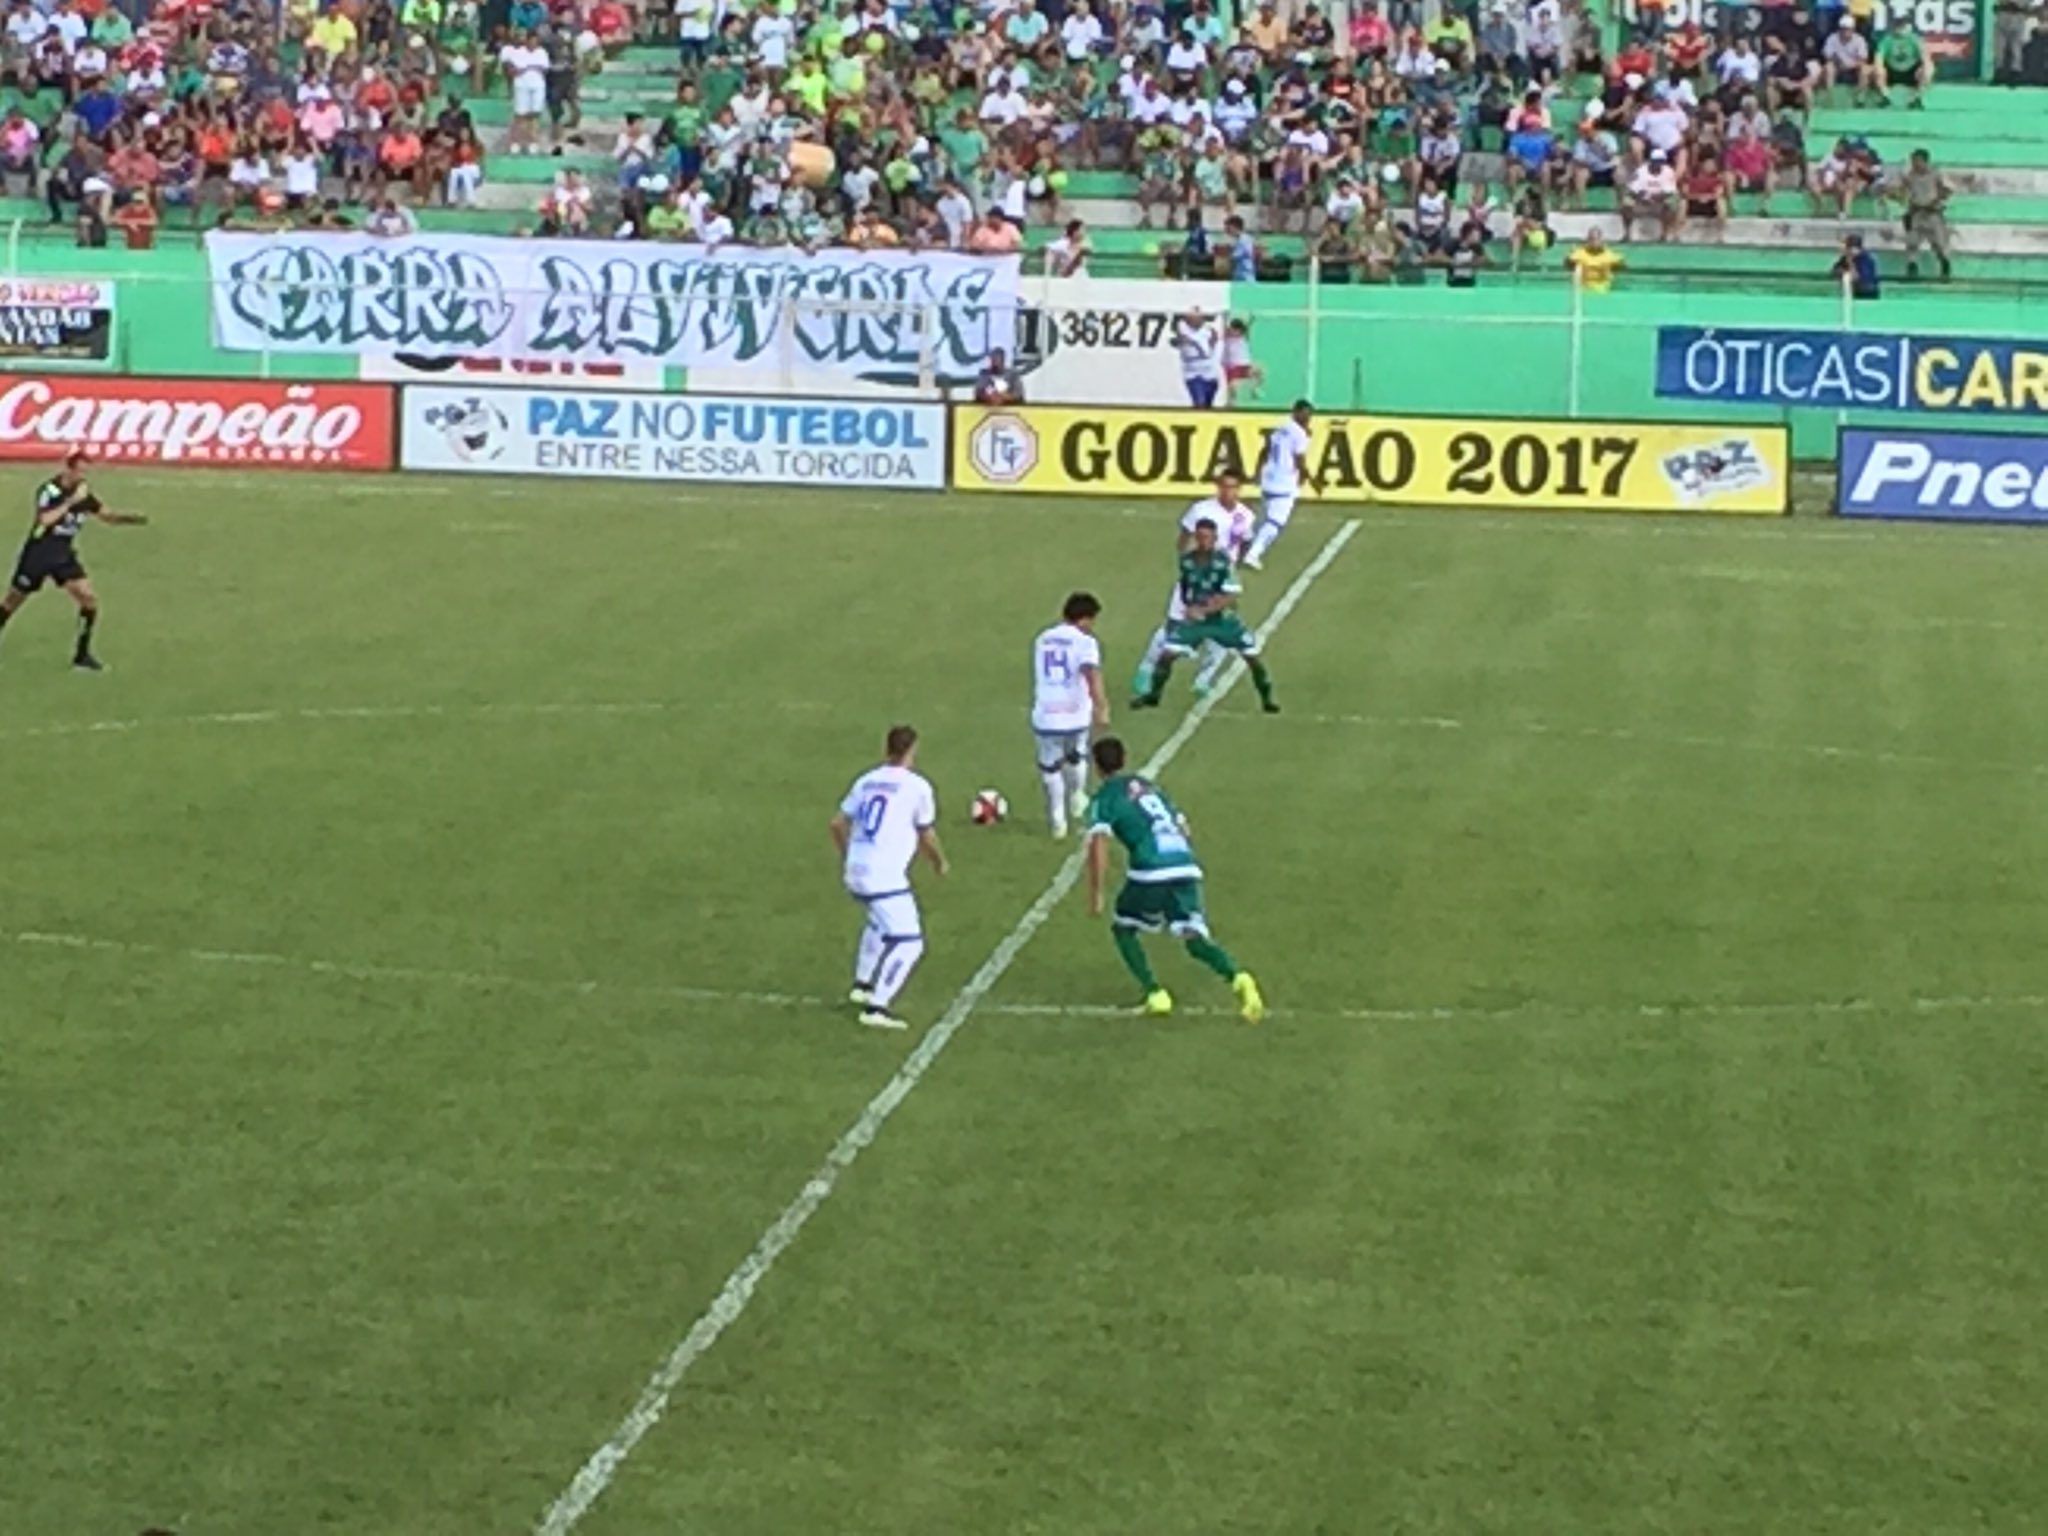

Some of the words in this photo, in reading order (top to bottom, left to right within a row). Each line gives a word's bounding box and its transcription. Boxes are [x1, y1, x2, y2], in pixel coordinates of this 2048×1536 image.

[1061, 309, 1131, 348] 3612
[1685, 328, 1892, 401] ÓTICAS
[0, 380, 362, 460] Campeão
[527, 396, 619, 439] PAZ
[631, 400, 697, 441] NO
[702, 403, 929, 449] FUTEBOL
[536, 440, 641, 471] ENTRE
[654, 443, 761, 476] NESSA
[773, 449, 916, 479] TORCIDA
[1447, 432, 1640, 496] 2017
